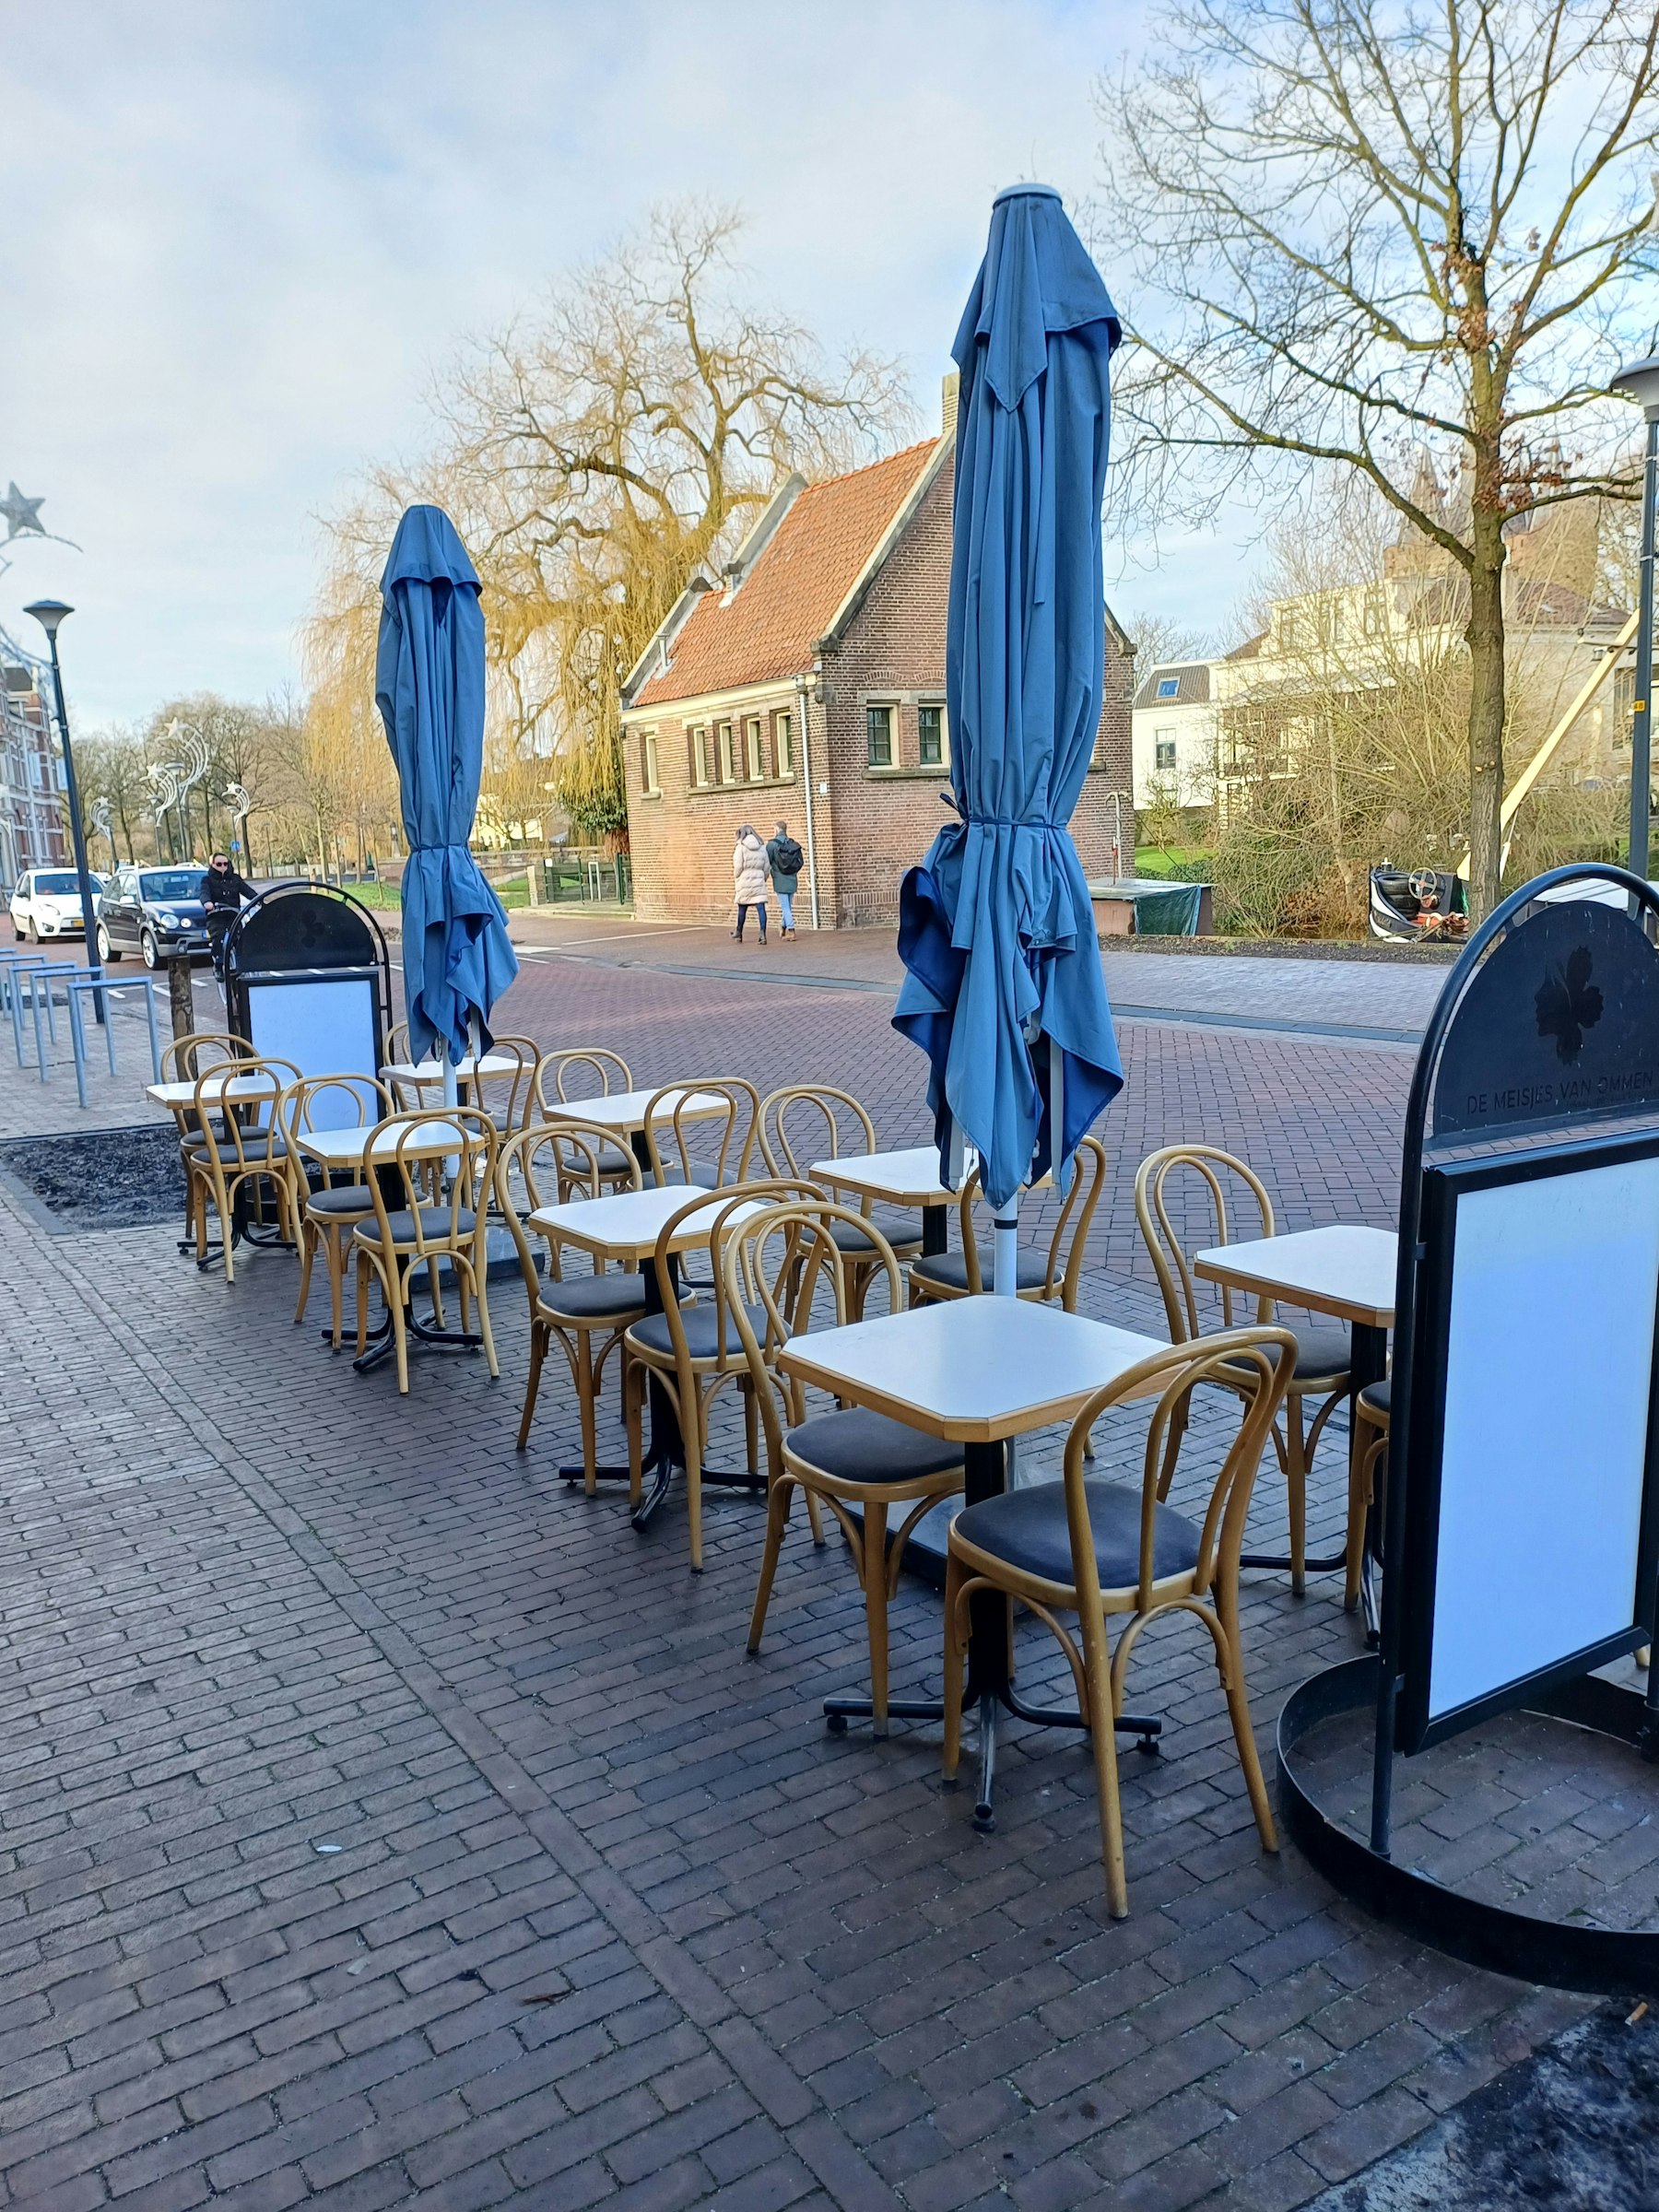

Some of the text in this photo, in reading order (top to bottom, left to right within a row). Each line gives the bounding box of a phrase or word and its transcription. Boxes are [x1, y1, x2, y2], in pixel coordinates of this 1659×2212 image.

[1467, 1094, 1487, 1114] DE
[1494, 1085, 1553, 1111] MEISJES
[1560, 1078, 1592, 1100] VAN
[1597, 1070, 1653, 1094] OMMEN
